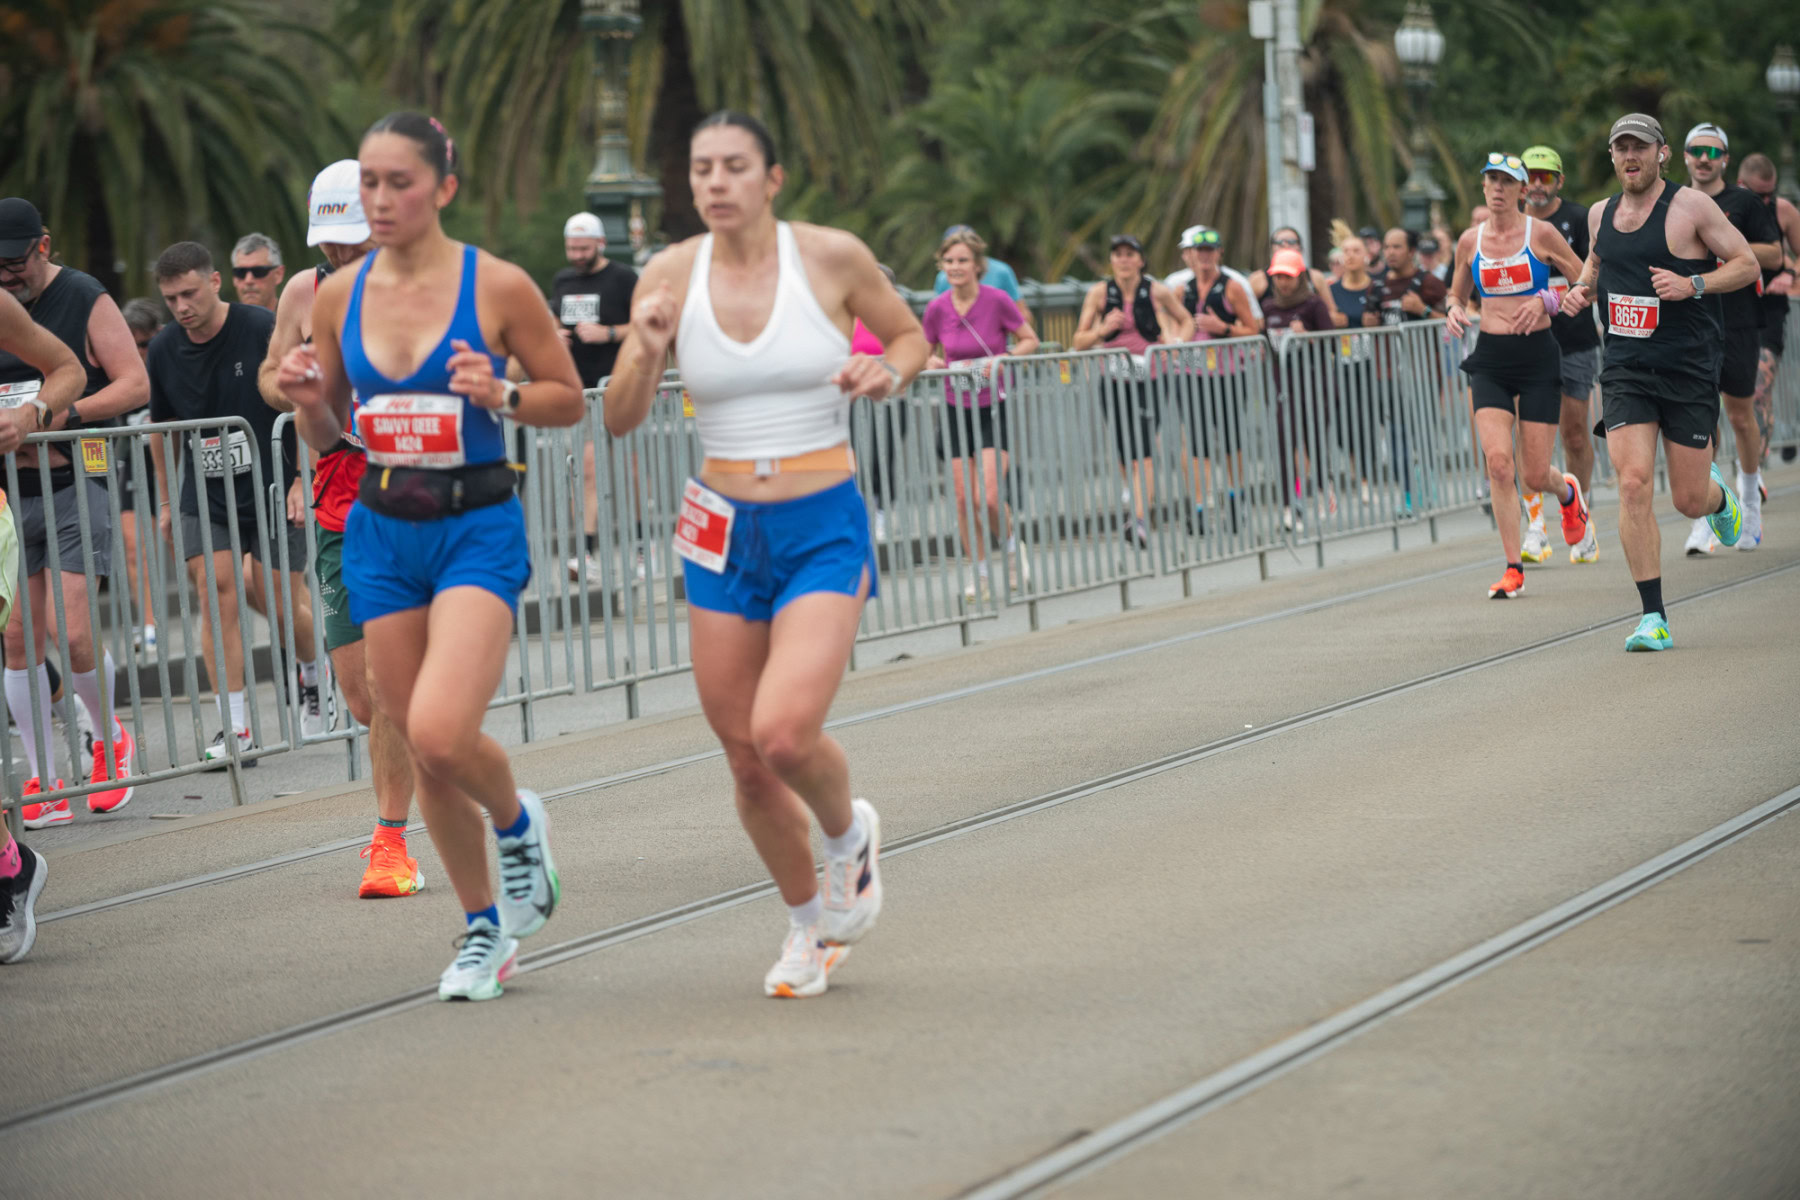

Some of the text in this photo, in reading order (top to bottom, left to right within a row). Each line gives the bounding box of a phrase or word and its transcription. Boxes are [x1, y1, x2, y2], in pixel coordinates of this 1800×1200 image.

[1617, 119, 1648, 128] SALOMON
[1615, 305, 1648, 327] 8657
[1612, 326, 1636, 335] MELBOURNE
